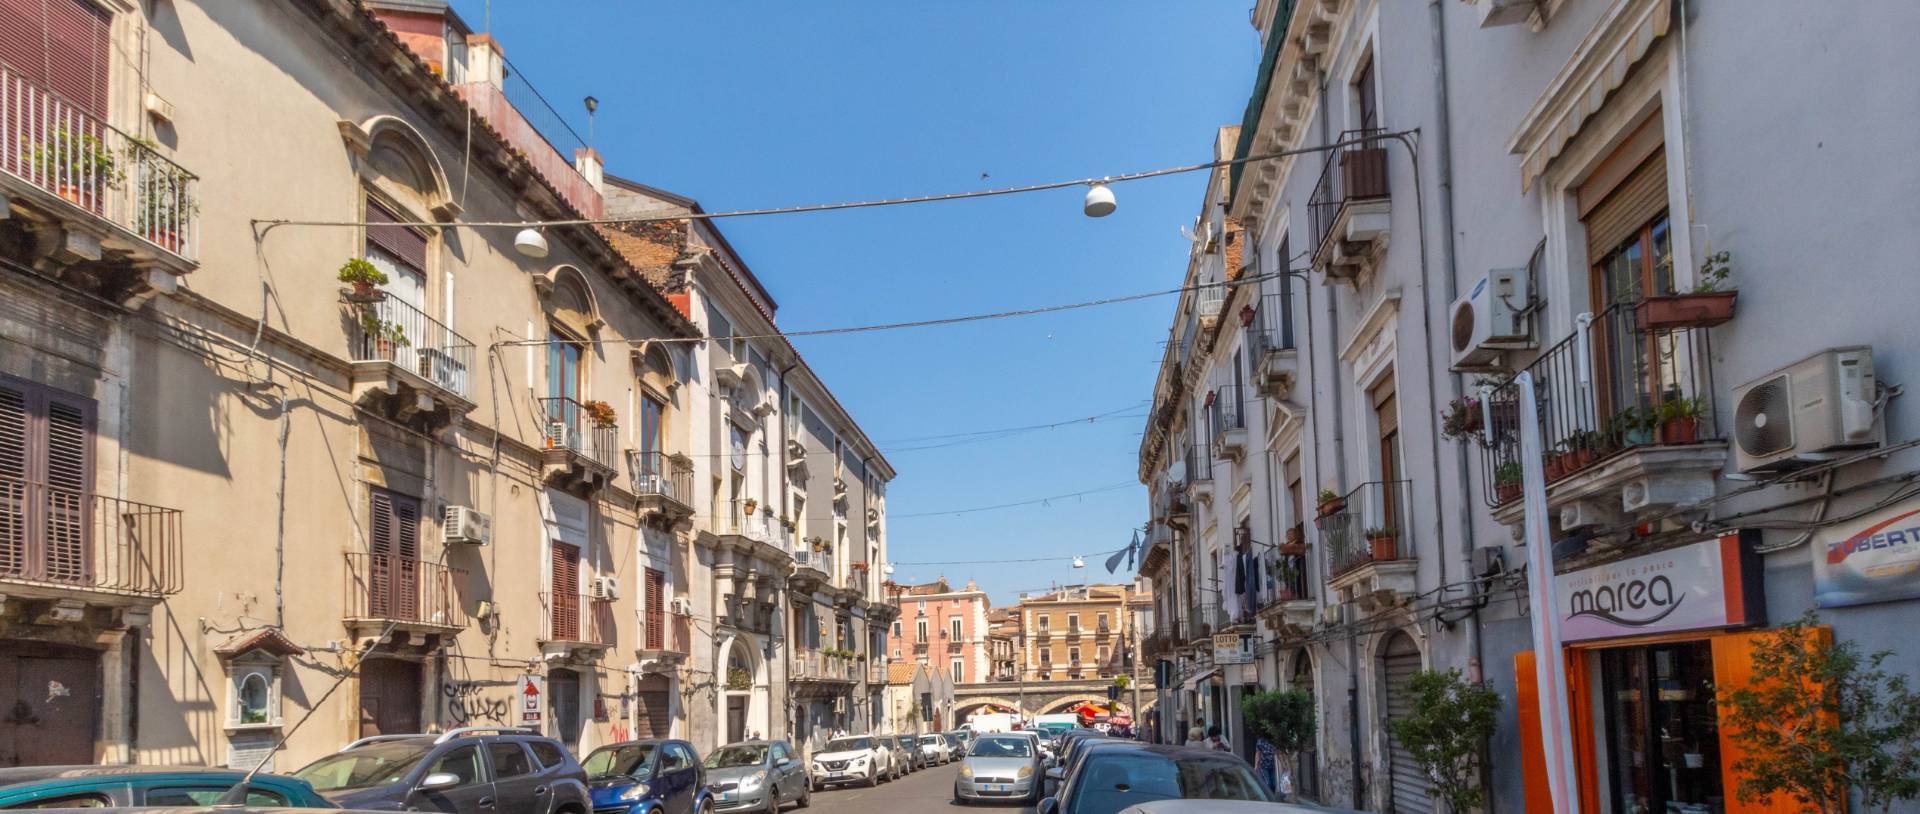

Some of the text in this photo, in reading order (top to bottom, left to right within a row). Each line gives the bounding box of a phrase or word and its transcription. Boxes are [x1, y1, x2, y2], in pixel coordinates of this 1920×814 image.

[1571, 575, 1673, 616] marea
[1215, 635, 1237, 643] LOTTO
[1239, 634, 1251, 652] T
